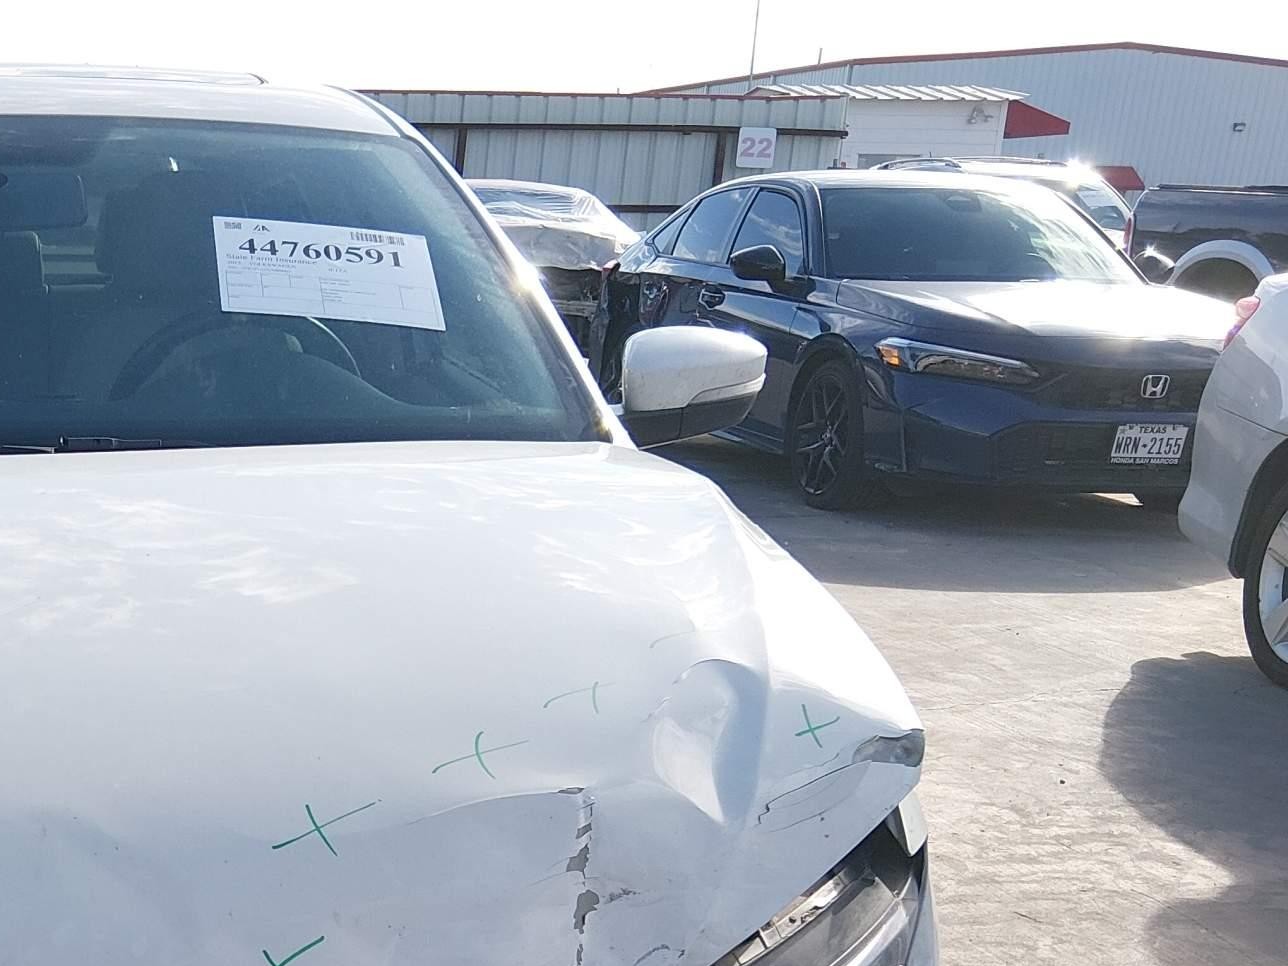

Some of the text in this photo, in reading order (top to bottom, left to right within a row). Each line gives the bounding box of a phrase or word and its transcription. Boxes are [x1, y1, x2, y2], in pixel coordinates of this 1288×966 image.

[740, 137, 773, 158] 22
[238, 238, 404, 268] 44760591
[1139, 426, 1167, 434] TEXAS
